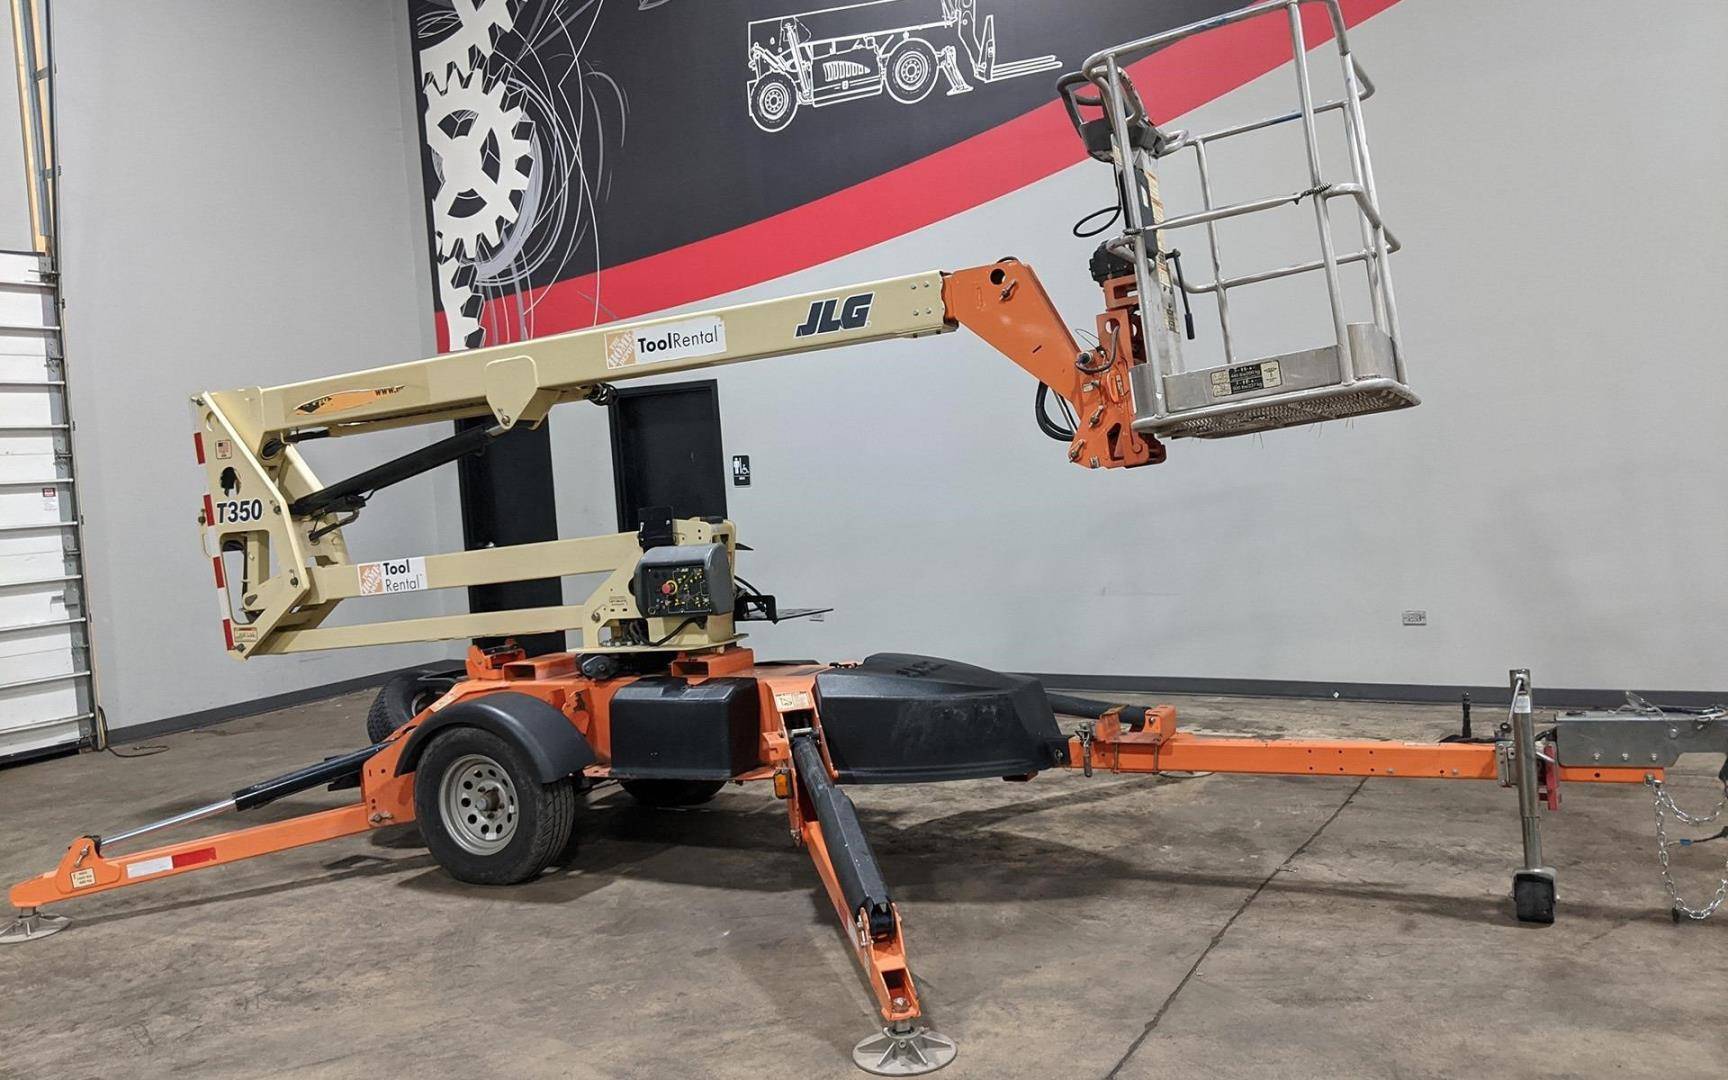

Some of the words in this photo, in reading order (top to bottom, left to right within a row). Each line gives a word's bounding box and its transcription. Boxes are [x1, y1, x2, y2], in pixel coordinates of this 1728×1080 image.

[795, 292, 874, 337] JLG
[216, 499, 263, 524] T350
[383, 559, 410, 576] Tool
[385, 574, 420, 592] Rental
